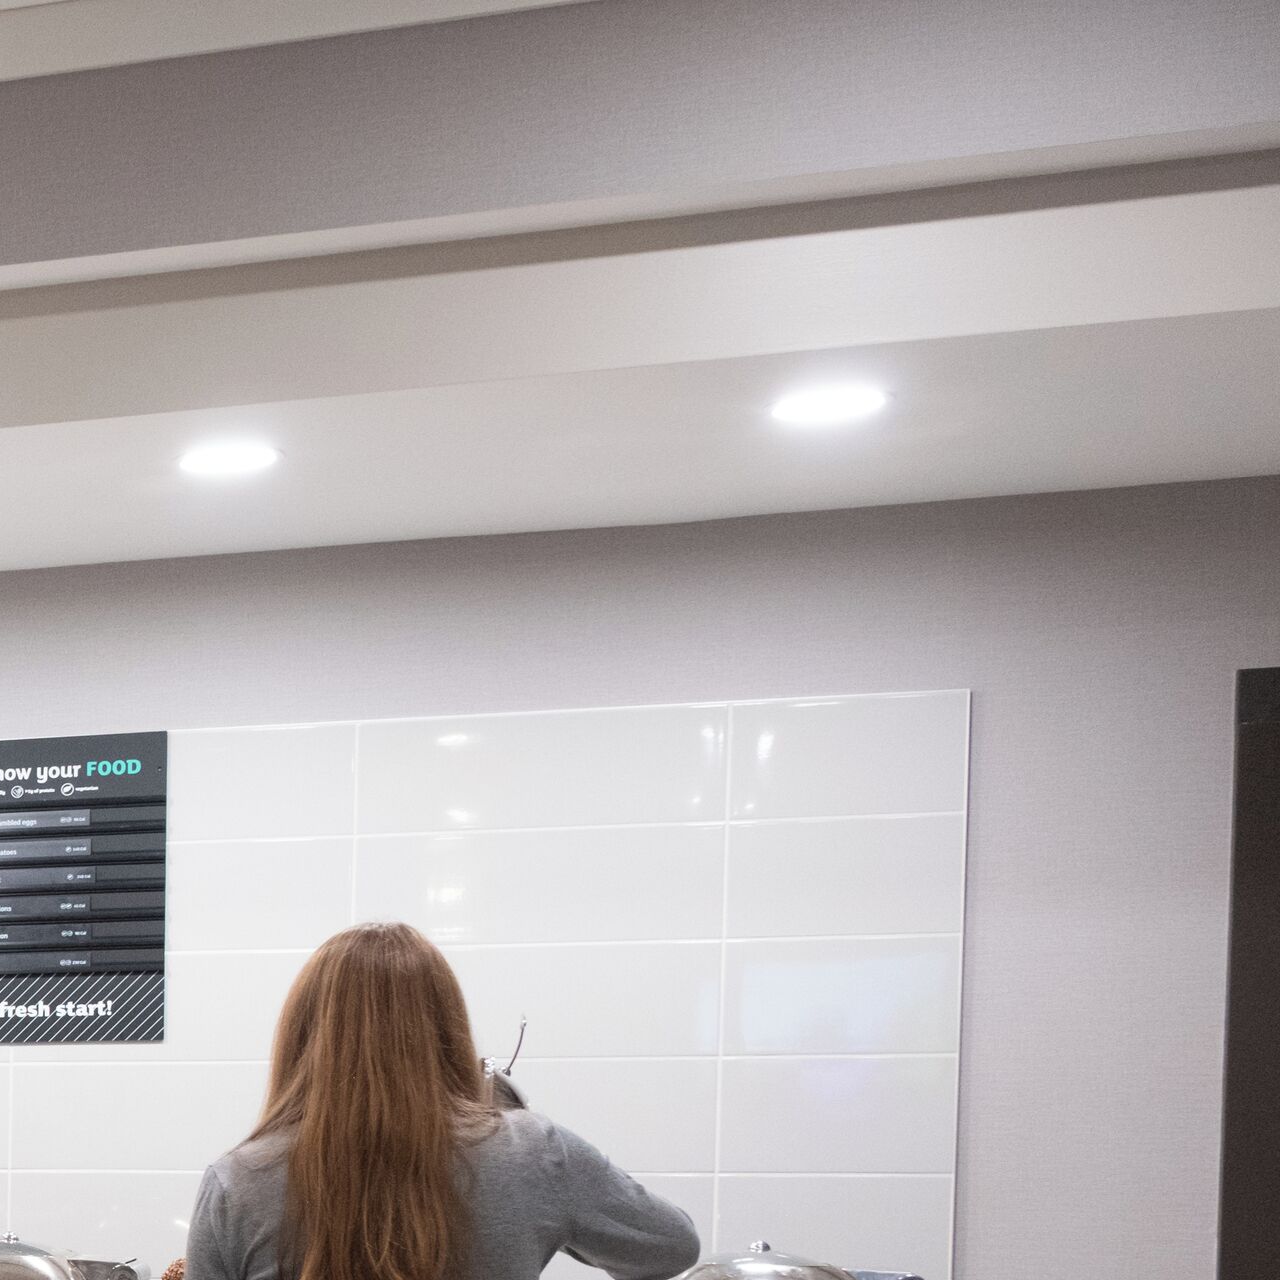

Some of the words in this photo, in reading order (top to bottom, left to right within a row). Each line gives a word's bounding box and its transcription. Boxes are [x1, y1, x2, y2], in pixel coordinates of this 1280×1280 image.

[37, 765, 81, 783] your
[86, 759, 141, 776] FOOD
[22, 819, 37, 827] eggs
[55, 1000, 113, 1017] start!
